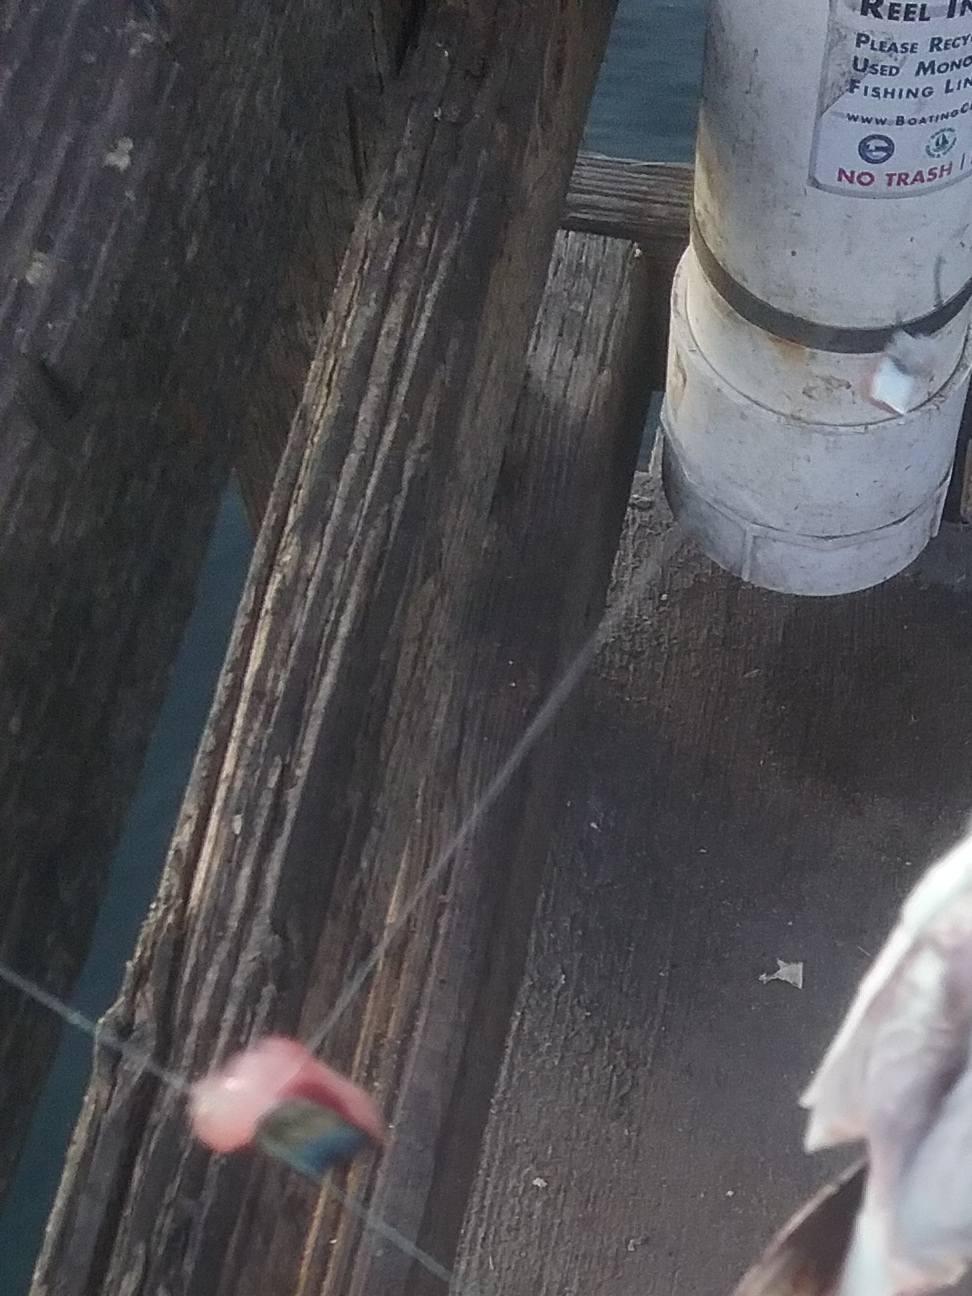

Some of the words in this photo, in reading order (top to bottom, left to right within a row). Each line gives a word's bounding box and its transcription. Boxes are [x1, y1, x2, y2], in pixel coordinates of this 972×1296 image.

[855, 33, 919, 54] PLEASE
[851, 55, 900, 77] USED
[847, 77, 934, 100] FISHING
[837, 167, 875, 187] NO
[885, 161, 953, 188] TRASH
